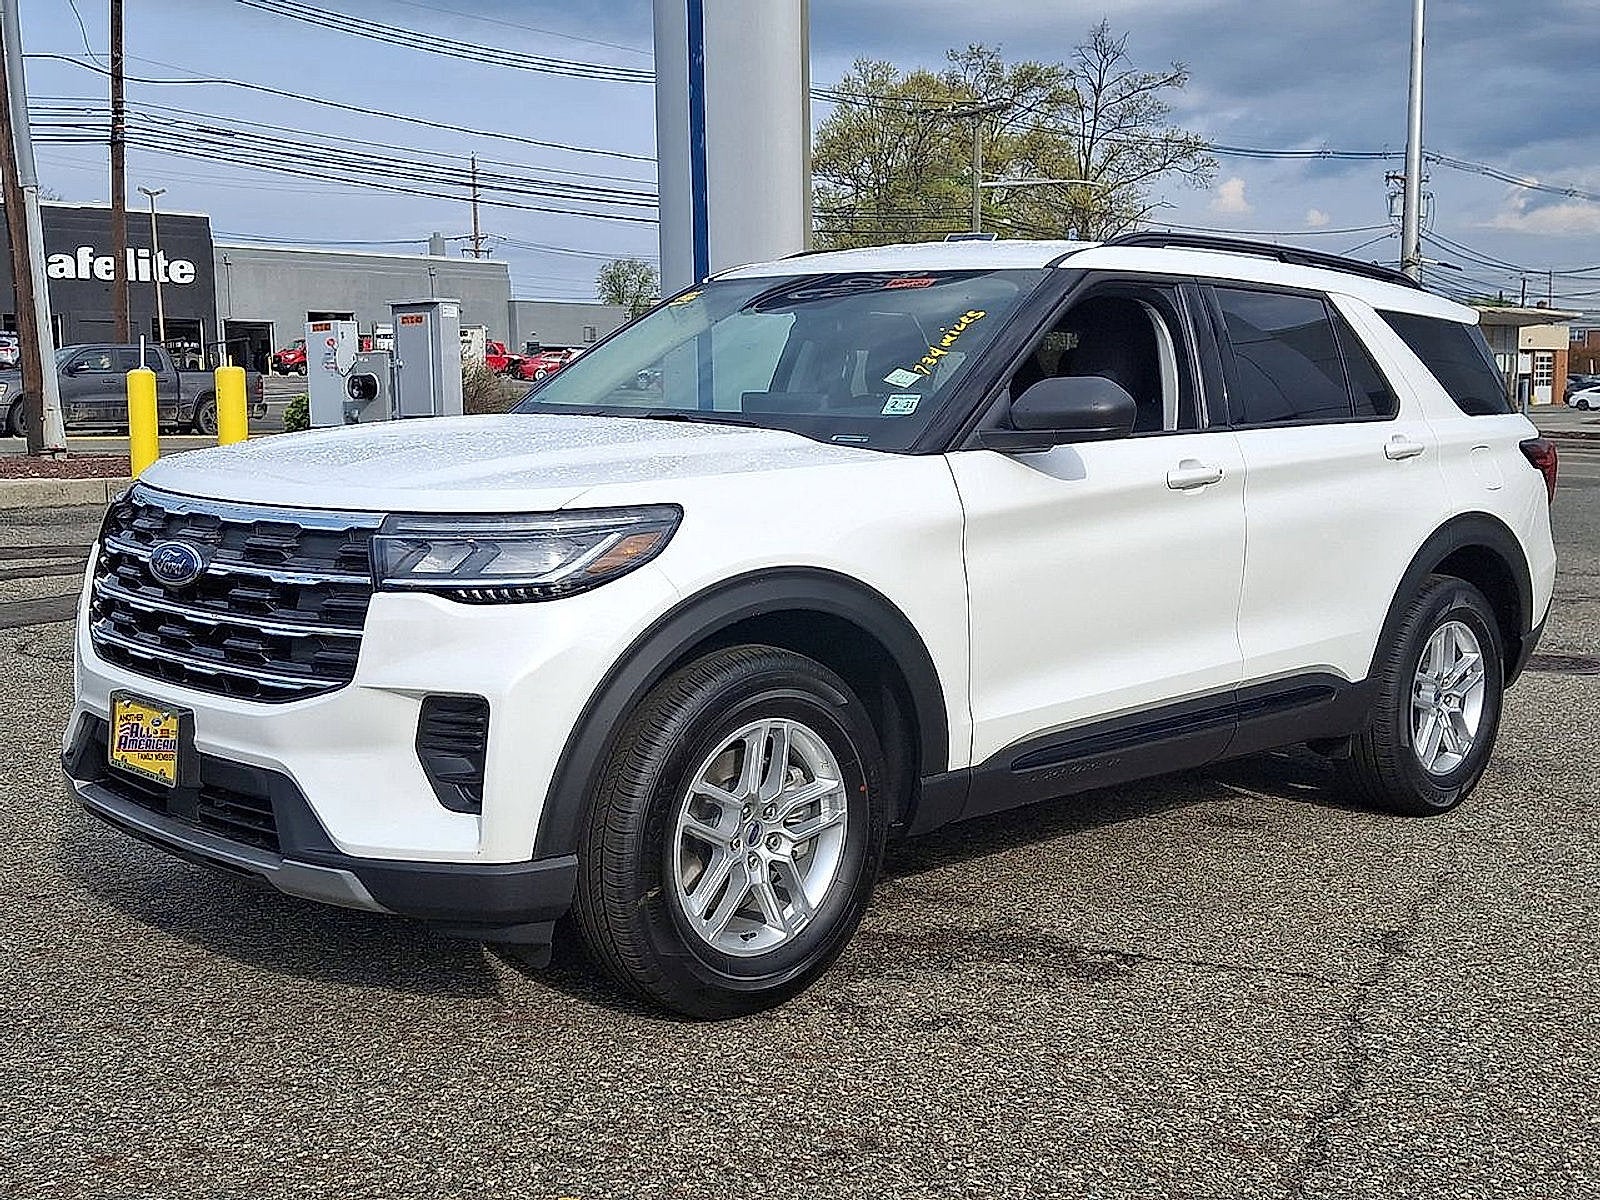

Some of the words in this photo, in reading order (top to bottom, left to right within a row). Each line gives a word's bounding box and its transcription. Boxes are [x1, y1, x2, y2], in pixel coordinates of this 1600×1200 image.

[47, 246, 196, 285] afelite
[155, 548, 187, 575] Ford
[118, 713, 144, 723] ANOTHER
